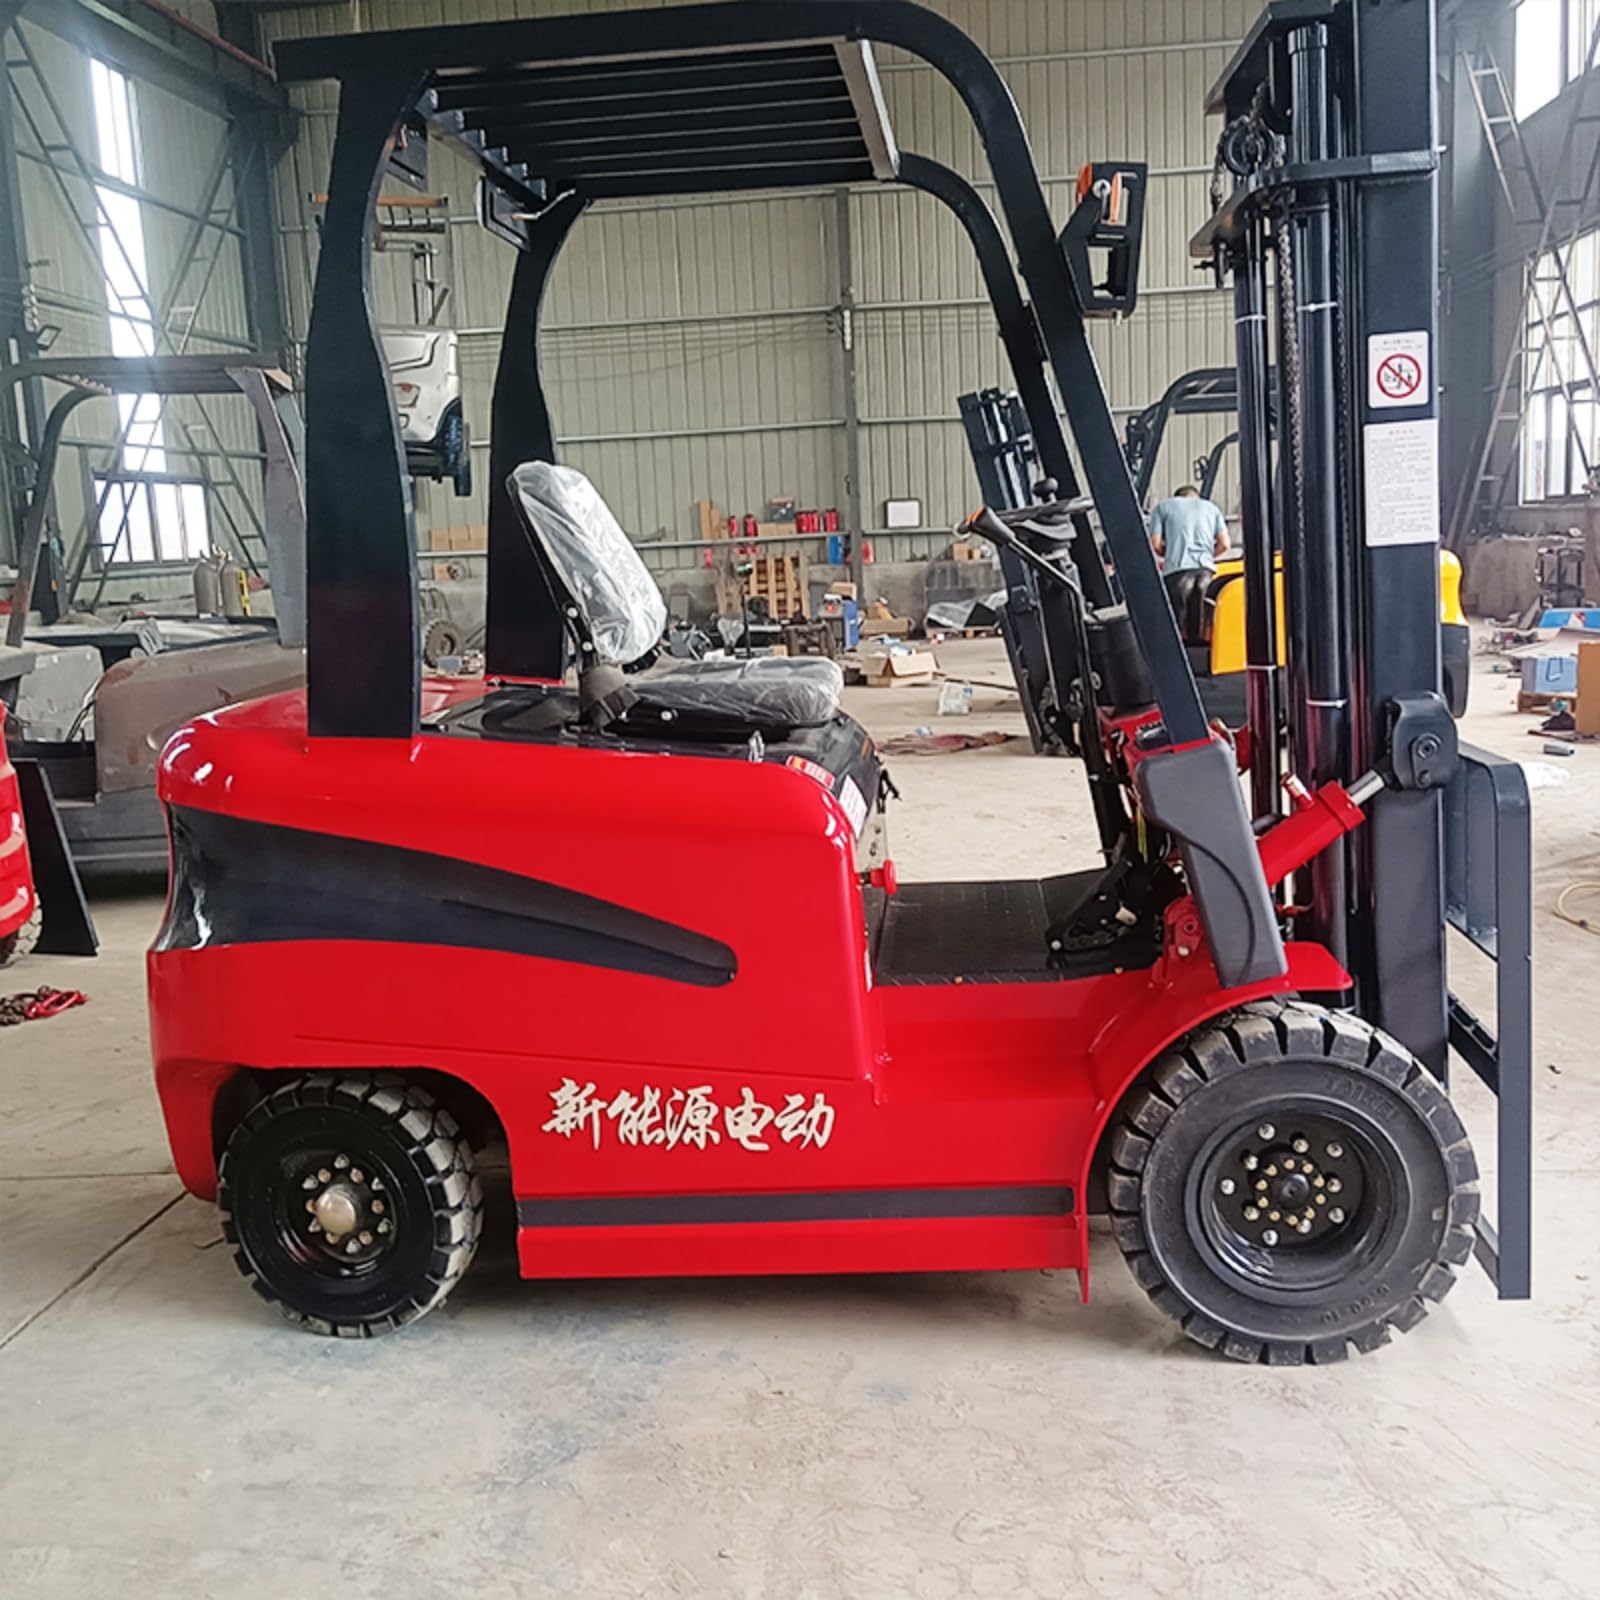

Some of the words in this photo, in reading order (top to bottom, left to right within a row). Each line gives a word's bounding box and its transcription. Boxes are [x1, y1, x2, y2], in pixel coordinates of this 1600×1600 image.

[541, 1077, 835, 1151] 新能源电动
